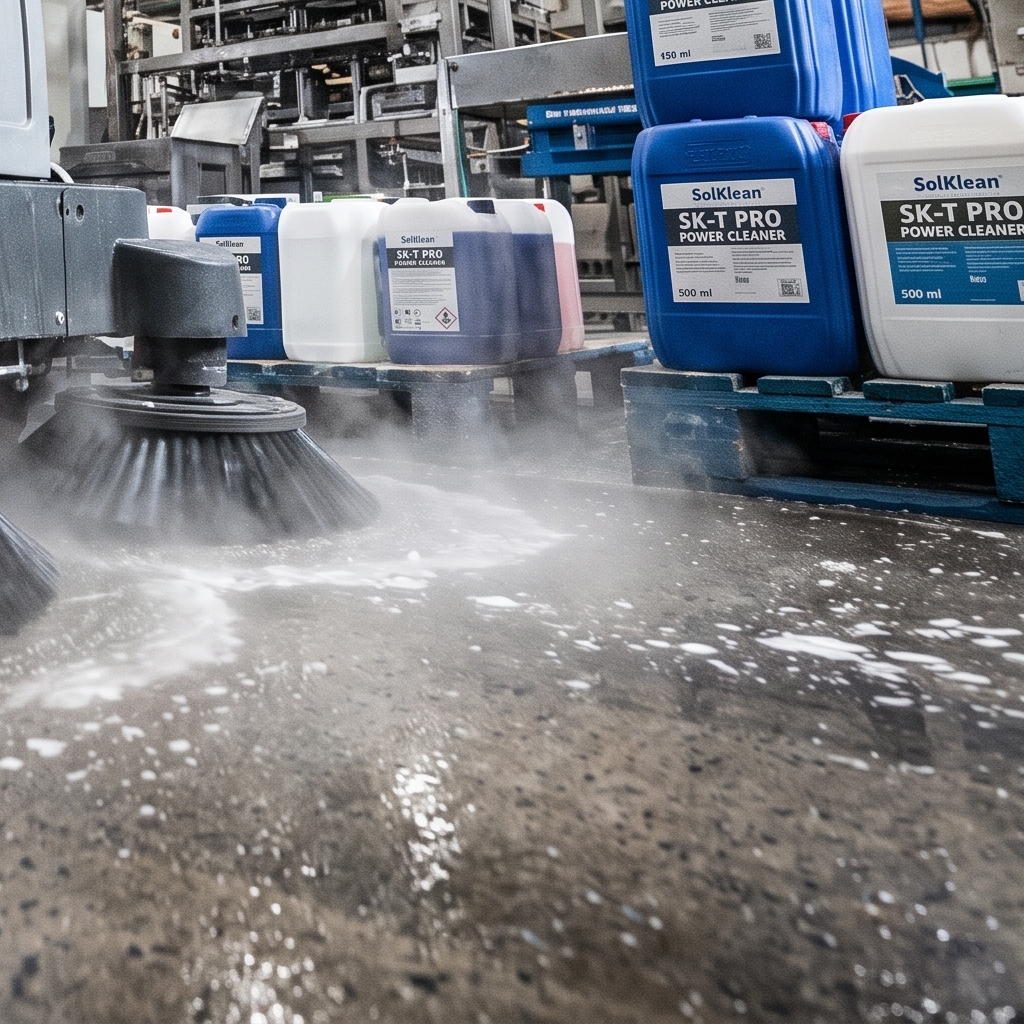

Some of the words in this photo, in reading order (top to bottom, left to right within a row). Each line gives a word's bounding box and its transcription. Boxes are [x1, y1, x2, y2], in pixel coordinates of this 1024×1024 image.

[679, 49, 691, 59] ml
[913, 174, 1000, 192] SolKlean
[692, 187, 762, 202] SolKlean
[899, 202, 958, 224] SK-T
[966, 200, 1024, 222] PRO
[678, 211, 728, 230] SK-T
[734, 209, 782, 229] PRO
[679, 231, 725, 243] POWER
[727, 229, 787, 241] CLEANER
[900, 225, 955, 238] POWER
[958, 223, 1024, 237] CLEANER
[396, 250, 420, 259] SK-T
[422, 249, 443, 259] PRO
[678, 288, 697, 297] 500
[700, 288, 713, 297] ml
[901, 289, 924, 299] 500
[926, 288, 942, 299] ml
